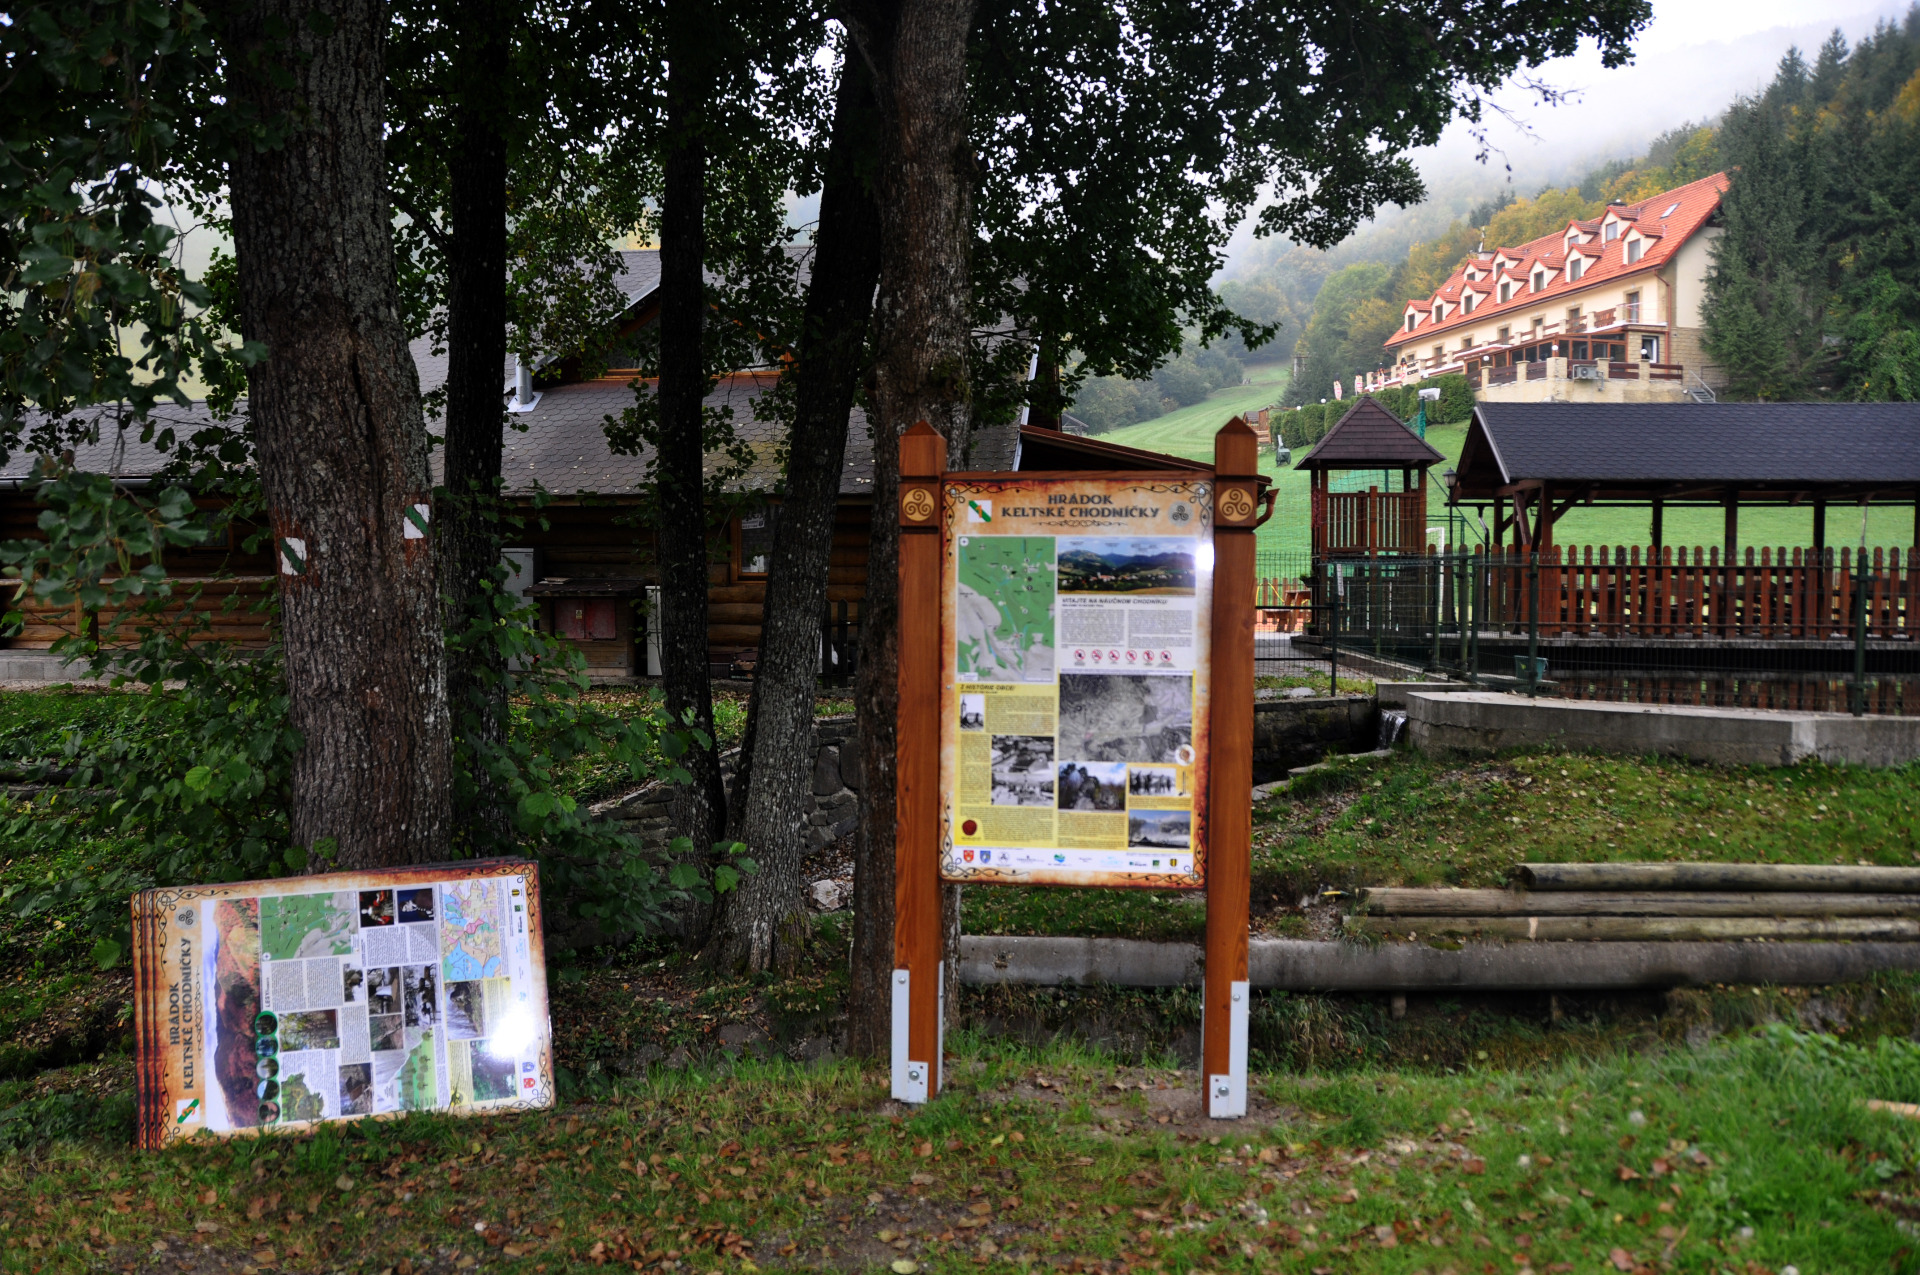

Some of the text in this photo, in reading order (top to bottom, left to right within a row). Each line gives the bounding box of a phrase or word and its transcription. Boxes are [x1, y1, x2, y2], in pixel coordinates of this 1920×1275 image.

[1048, 493, 1113, 505] HRÁDOK
[976, 505, 982, 518] 1
[1002, 505, 1160, 518] KELTSKÉ CHODNÍČKY
[169, 982, 180, 1045] HRÁDOK
[179, 937, 194, 1090] KELTSKÉ CHODNÍČKY
[181, 1106, 195, 1117] 3
